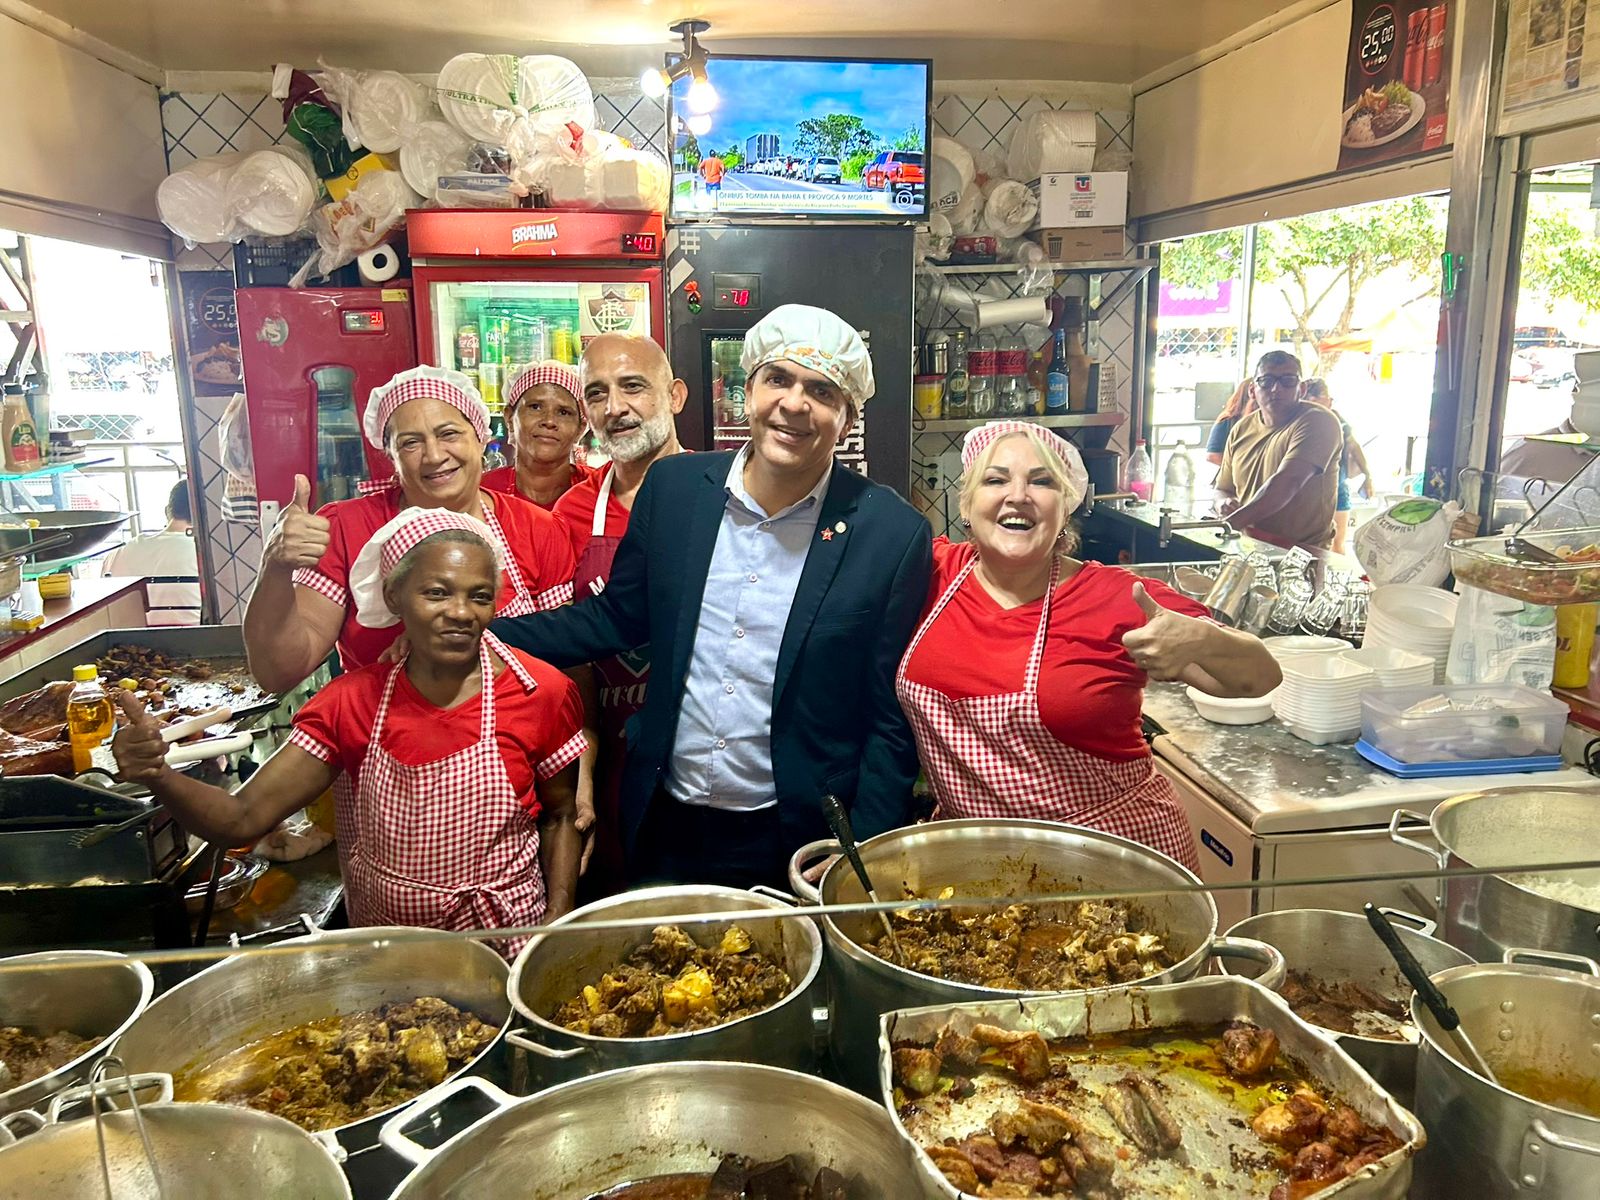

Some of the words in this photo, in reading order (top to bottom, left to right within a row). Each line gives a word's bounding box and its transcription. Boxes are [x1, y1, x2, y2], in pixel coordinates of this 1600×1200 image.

[1361, 24, 1394, 59] 25,00
[719, 191, 744, 199] ÔNIBUS
[745, 192, 769, 200] TOMBA
[808, 193, 841, 201] PROVOCA
[847, 193, 874, 201] MORTES
[512, 223, 558, 244] BRAHMA
